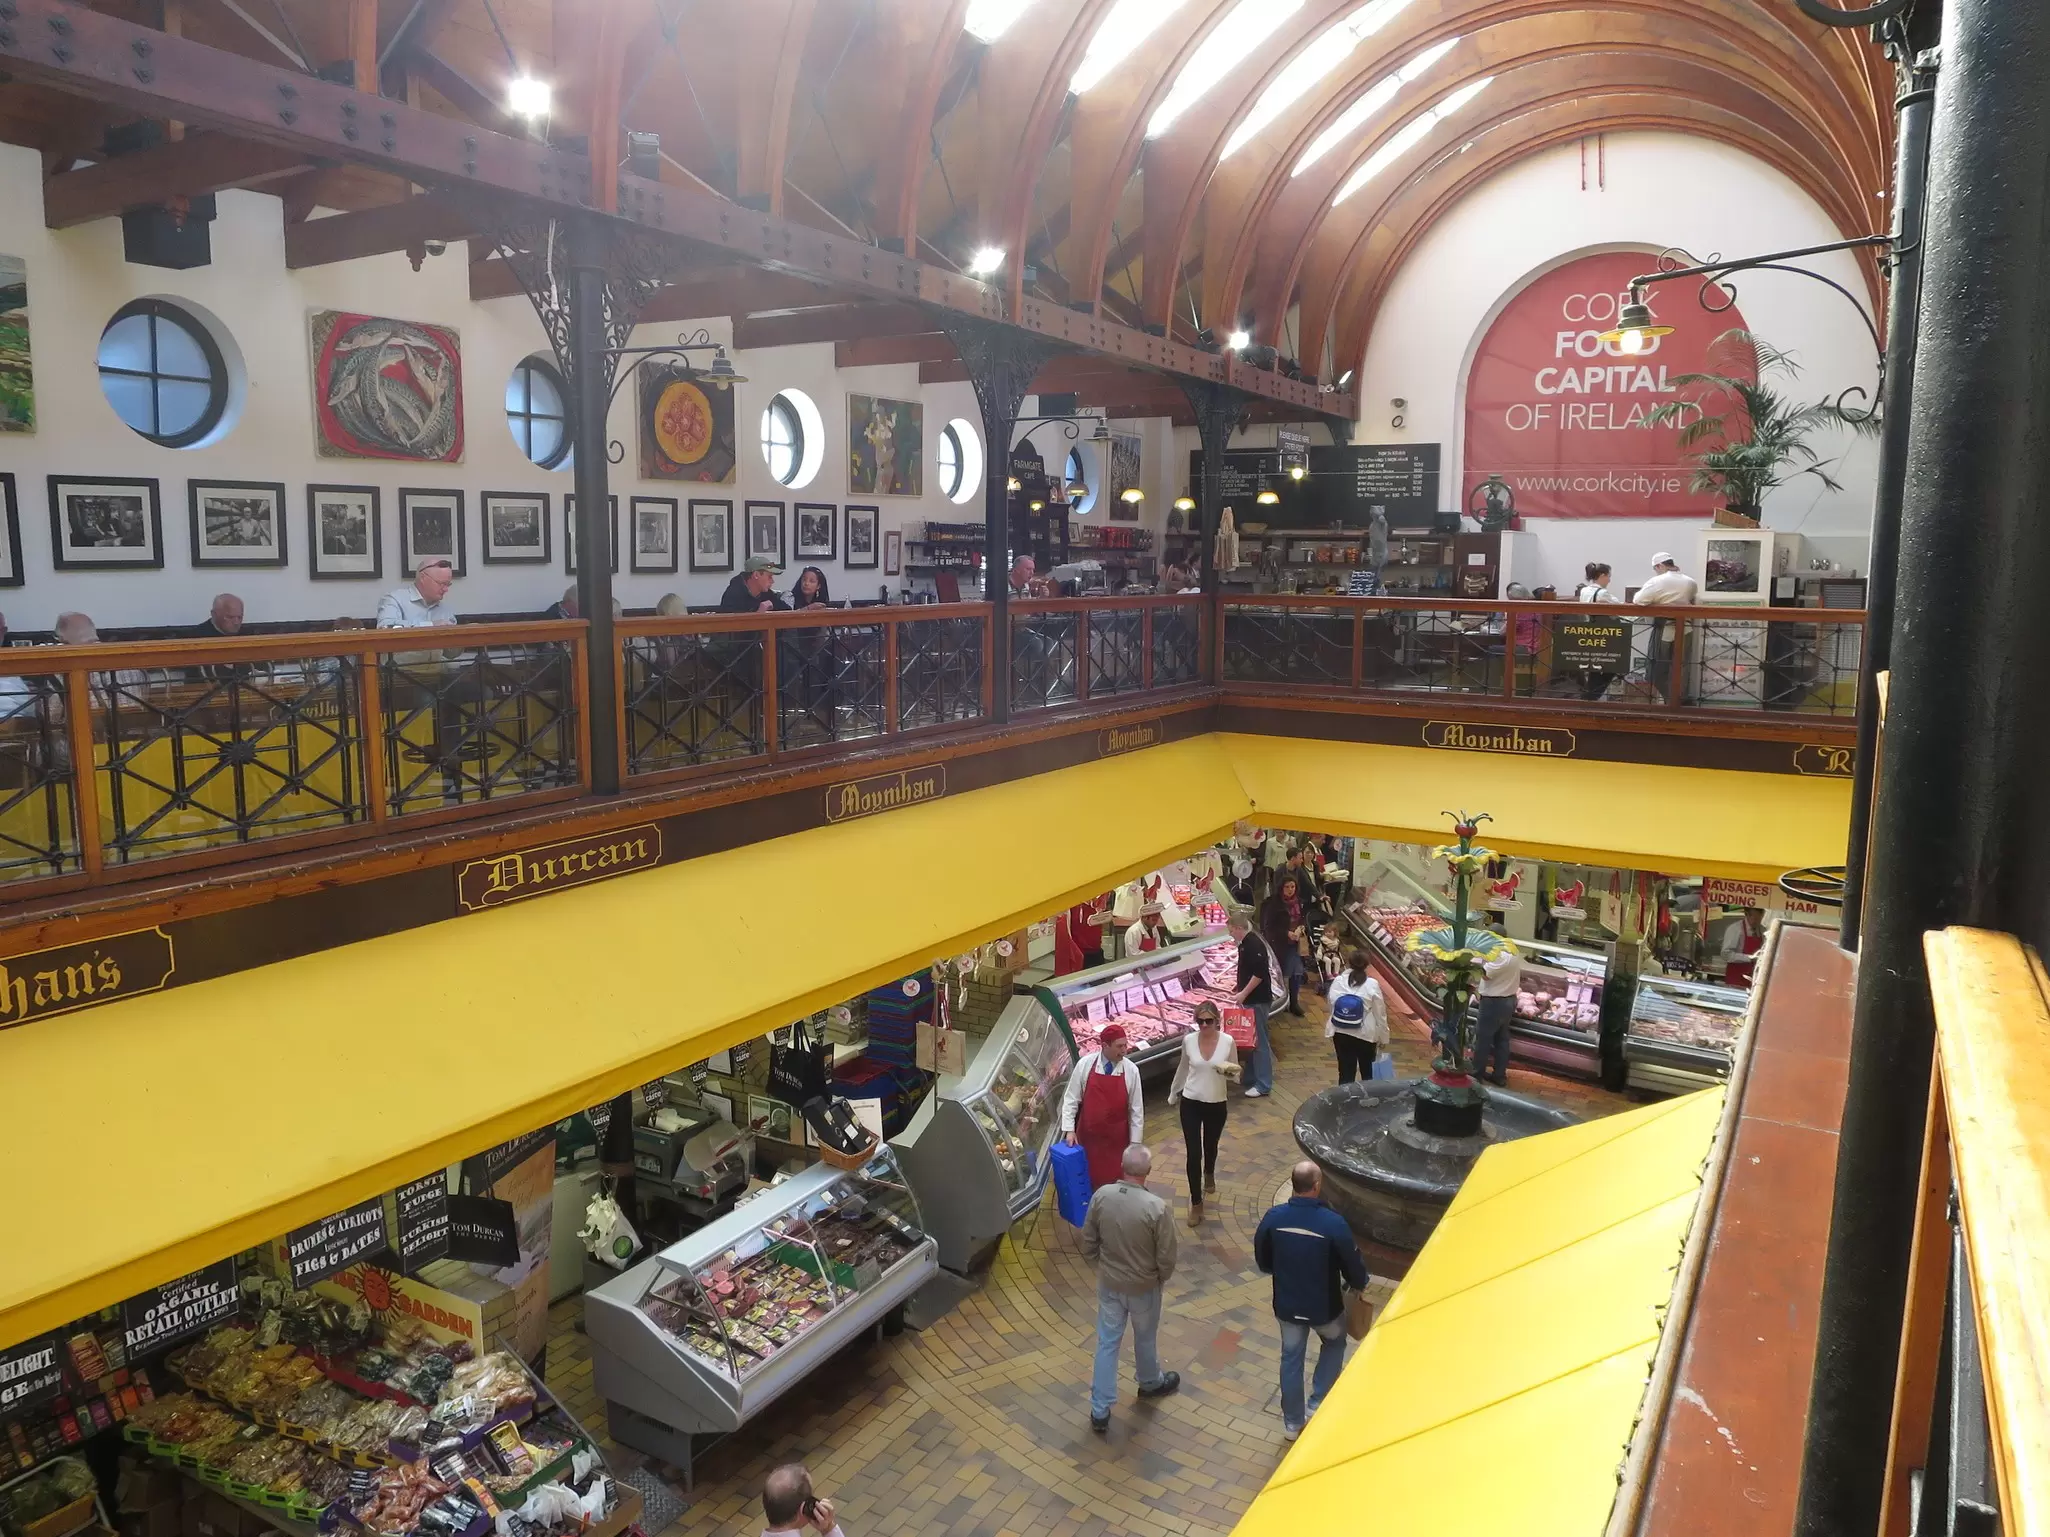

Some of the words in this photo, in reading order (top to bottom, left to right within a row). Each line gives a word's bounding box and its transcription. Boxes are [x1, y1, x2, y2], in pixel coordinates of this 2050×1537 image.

[1535, 365, 1677, 395] CAPITAL
[1505, 402, 1551, 432] OF
[1560, 401, 1703, 431] IRELAND
[1013, 459, 1042, 471] FARMGATE
[1516, 471, 1681, 498] www.corkcity.ie
[1563, 626, 1623, 637] FARMGATE
[1107, 724, 1154, 752] Moynihan
[1440, 724, 1553, 752] Moynihan
[835, 773, 935, 818] Moynihan
[481, 838, 647, 905] Durcan
[1709, 880, 1769, 897] AUSAGES
[1709, 893, 1756, 908] UDDING
[1785, 901, 1818, 914] HAM
[485, 1146, 506, 1168] TOM
[290, 1229, 328, 1259] PRUNES
[328, 1223, 336, 1237] &
[337, 1206, 383, 1233] APRICOTS
[400, 1215, 449, 1244] TURKISH
[403, 1226, 449, 1256] DELIGHT
[451, 1222, 471, 1232] TOM
[472, 1223, 504, 1238] DURCAN
[294, 1255, 327, 1277] FIGS
[329, 1251, 339, 1266] &
[341, 1226, 381, 1261] DATES
[144, 1281, 219, 1322] ORGANIC
[161, 1279, 198, 1300] Certified
[125, 1310, 183, 1348] RETAIL
[184, 1285, 239, 1321] OUTLET
[399, 1293, 473, 1339] GARDEN
